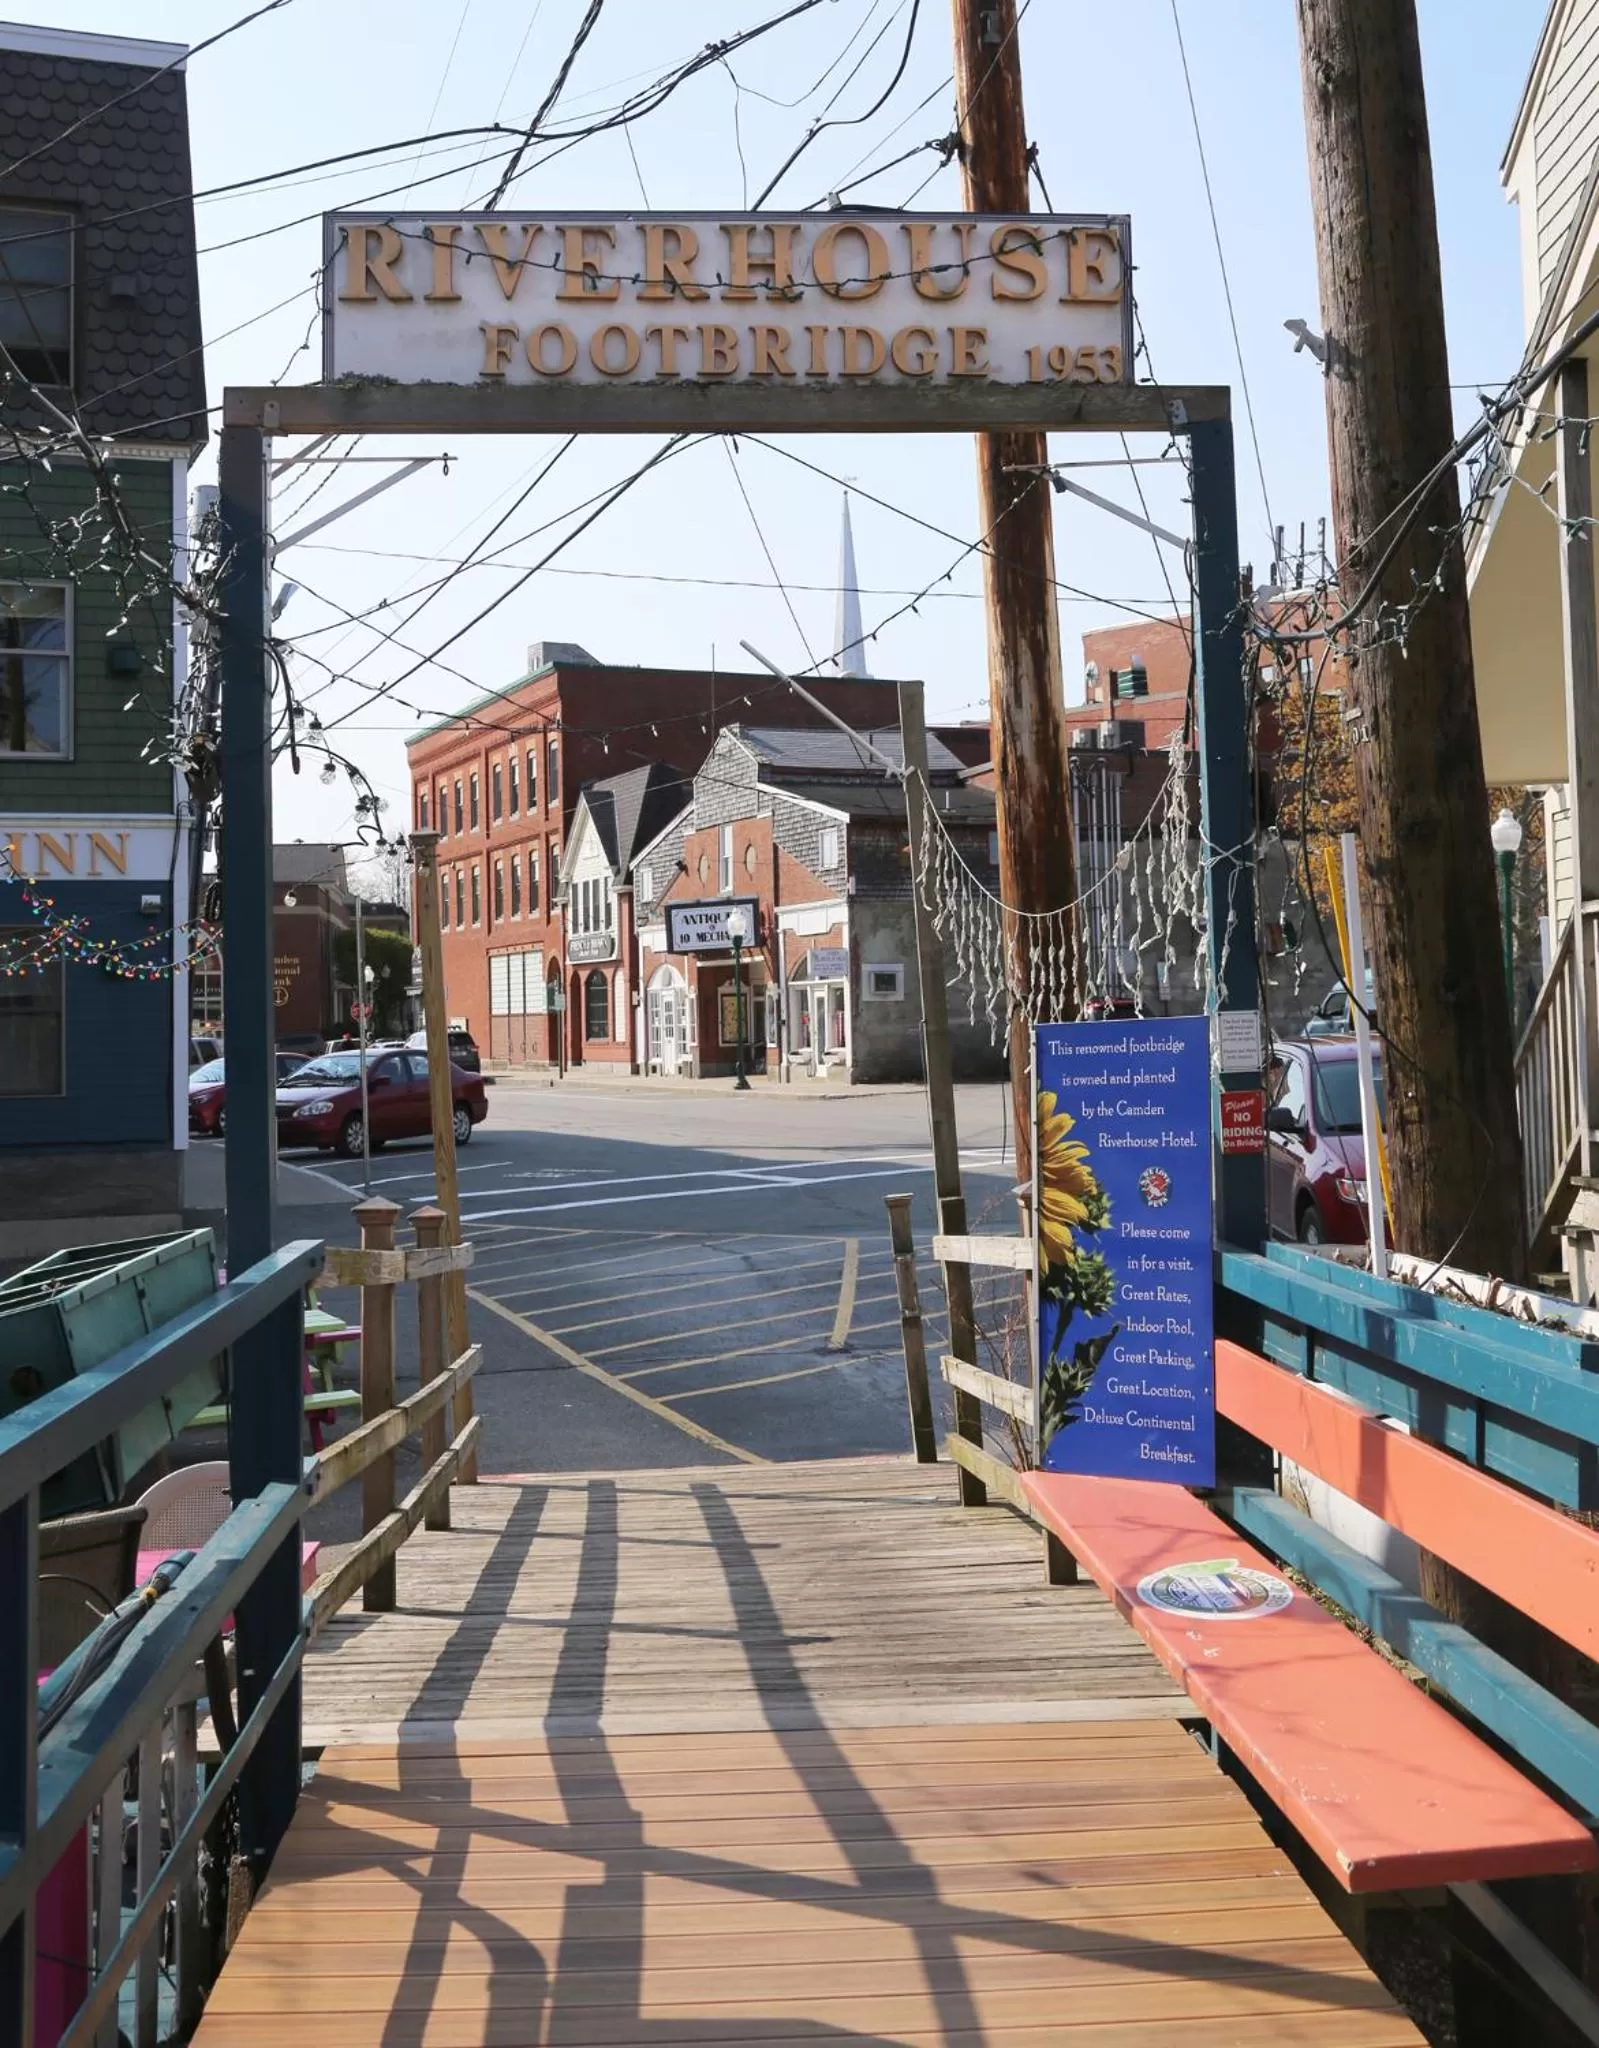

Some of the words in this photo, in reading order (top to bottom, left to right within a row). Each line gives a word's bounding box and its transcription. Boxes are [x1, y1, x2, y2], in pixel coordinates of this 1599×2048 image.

[338, 222, 1124, 304] RIVERHOUSE
[478, 324, 990, 378] FOOTBRIDGE
[1024, 344, 1124, 383] 1953
[4, 832, 131, 876] INN
[683, 911, 733, 925] ANTIQU
[696, 929, 732, 943] MECHA
[1048, 1040, 1073, 1056] This
[1075, 1037, 1127, 1055] renowned
[1129, 1036, 1185, 1056] footbridge
[1062, 1073, 1072, 1086] is
[1073, 1069, 1108, 1086] owned
[1109, 1068, 1131, 1085] and
[1133, 1067, 1176, 1087] planted
[1081, 1101, 1096, 1119] by
[1097, 1101, 1115, 1117] the
[1116, 1100, 1165, 1117] Camden
[1224, 1098, 1255, 1113] Please
[1233, 1112, 1252, 1122] NO
[1098, 1132, 1159, 1148] Riverhouse
[1161, 1131, 1197, 1147] Hotel.
[1223, 1126, 1263, 1137] RIDING
[1121, 1222, 1157, 1238] Please
[1159, 1228, 1190, 1239] come
[1127, 1255, 1139, 1269] in
[1141, 1254, 1156, 1271] for
[1158, 1261, 1165, 1269] a
[1167, 1257, 1194, 1270] visit.
[1121, 1284, 1154, 1301] Great
[1156, 1286, 1191, 1304] Rates,
[1126, 1315, 1164, 1332] Indoor
[1166, 1318, 1195, 1336] Pool,
[1113, 1347, 1146, 1363] Great
[1106, 1377, 1140, 1394] Great
[1142, 1380, 1196, 1400] Location,
[1084, 1407, 1124, 1425] Deluxe
[1126, 1410, 1195, 1431] Continental
[1140, 1443, 1196, 1464] Breakfast.
